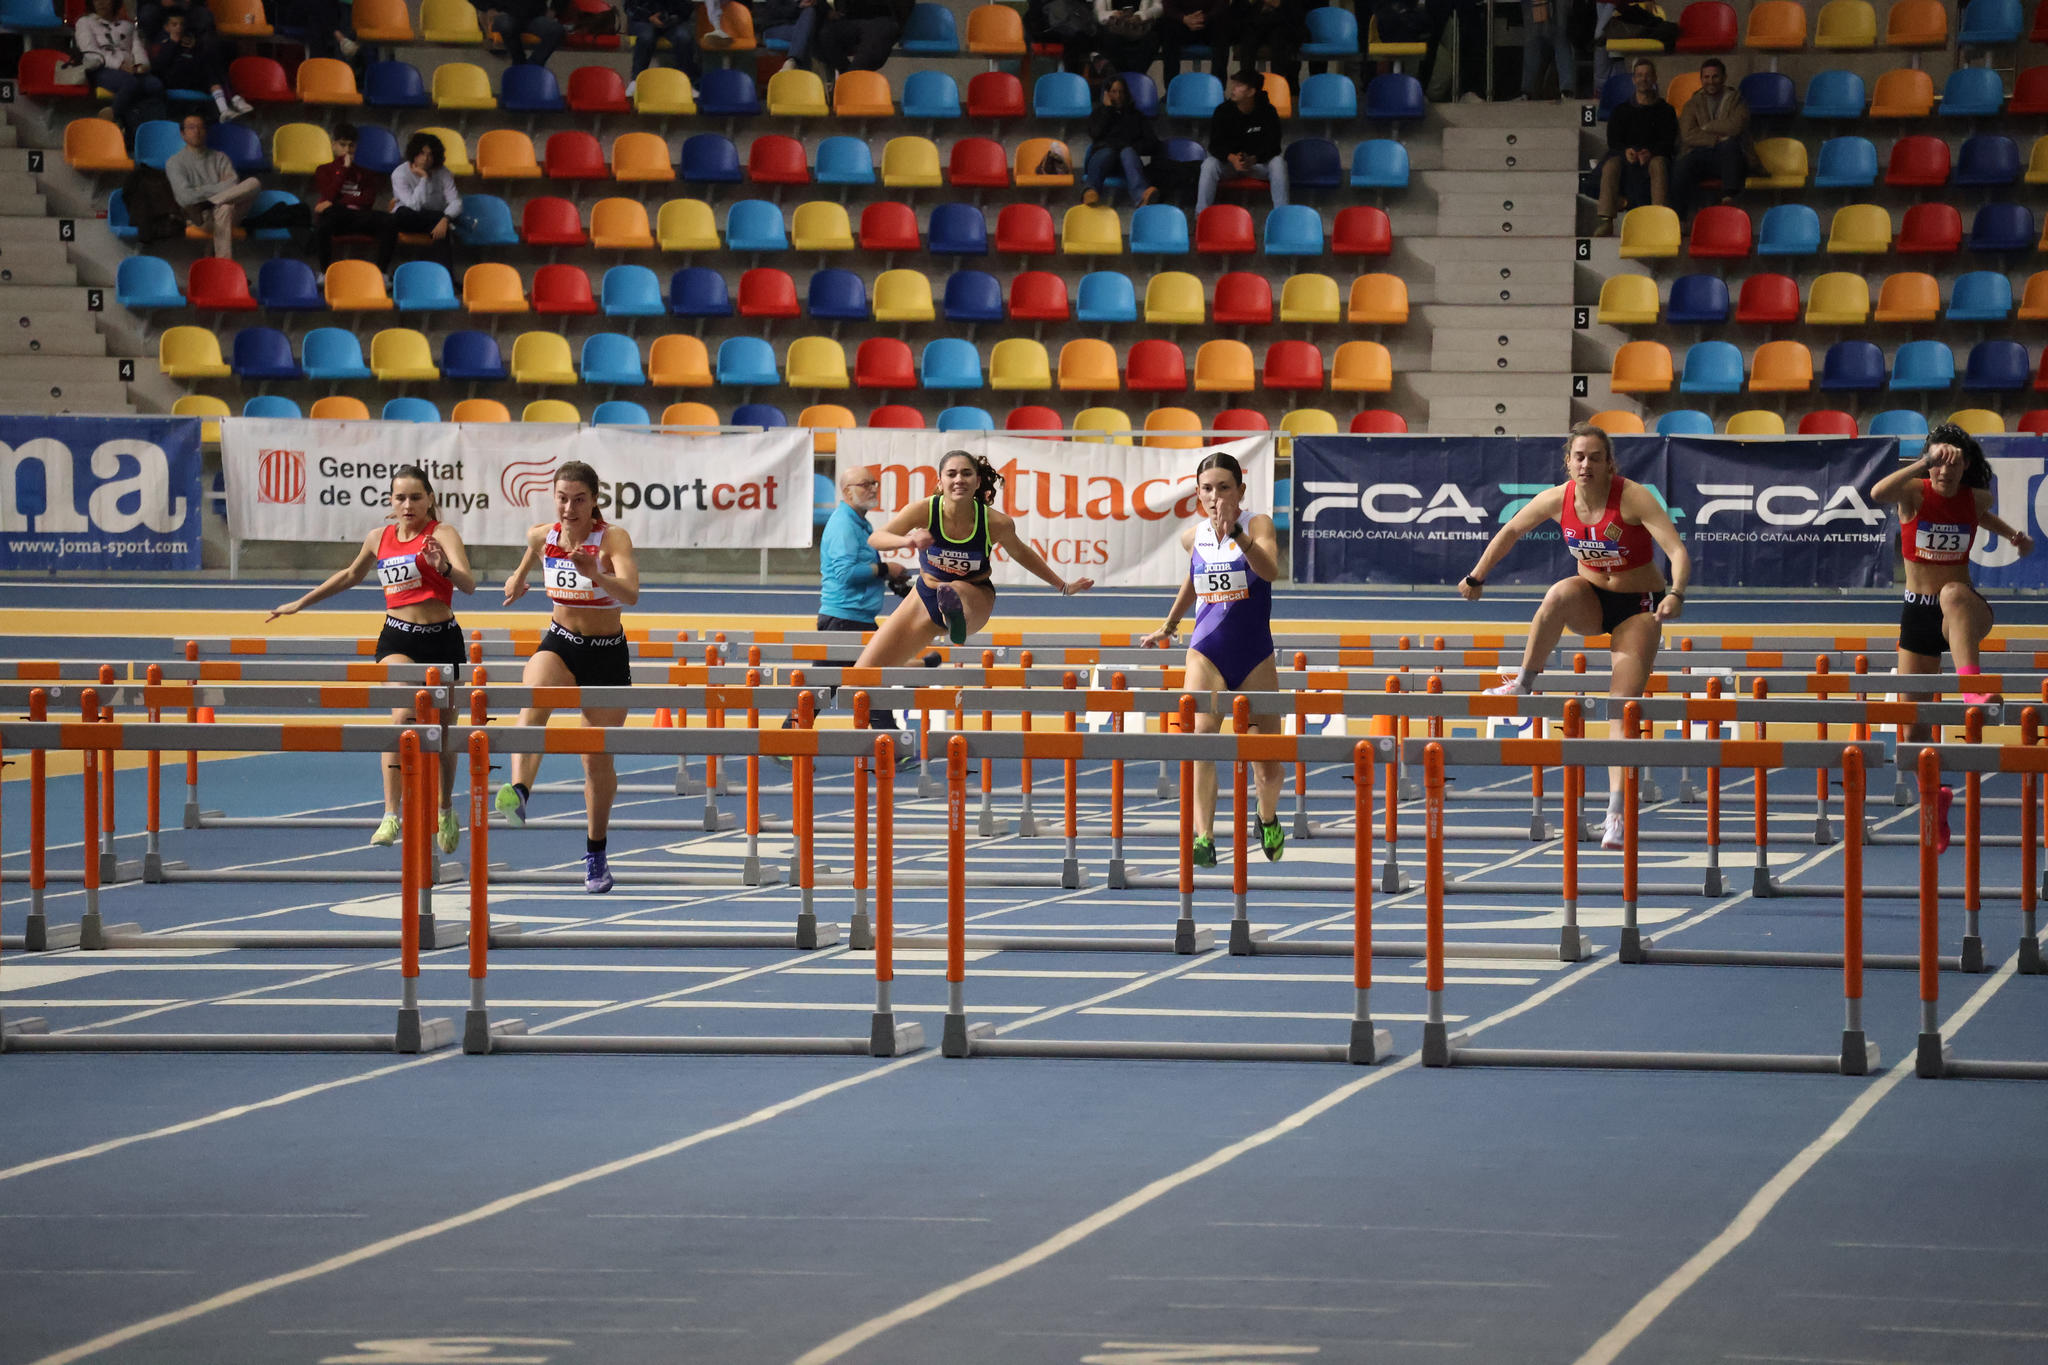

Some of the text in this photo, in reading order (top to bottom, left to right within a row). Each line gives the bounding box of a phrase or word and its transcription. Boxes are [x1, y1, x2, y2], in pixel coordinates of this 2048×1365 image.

[2, 85, 11, 98] 8
[1584, 110, 1593, 122] 8
[31, 155, 40, 168] 7
[62, 224, 71, 238] 6
[1578, 243, 1588, 256] 6
[91, 293, 100, 307] 5
[1577, 312, 1586, 325] 5
[121, 363, 131, 377] 4
[1575, 380, 1585, 393] 4
[320, 485, 351, 506] de
[1302, 481, 1489, 524] FCA
[1695, 484, 1887, 525] FCA
[1301, 528, 1489, 541] FEDERACIÓ CATALANA ATLETISME
[1695, 531, 1758, 542] FEDERACIÓ
[1760, 532, 1821, 543] CATALANA
[1823, 533, 1887, 543] ATLETISME
[1925, 533, 1960, 550] 123
[9, 538, 188, 557] www.joma-sport.com
[937, 557, 971, 572] 129
[384, 566, 412, 584] 122
[556, 571, 577, 588] 63
[1208, 573, 1231, 591] 58
[386, 617, 412, 631] NIKE
[412, 624, 442, 633] PRO
[556, 628, 622, 647] PRO NIKE
